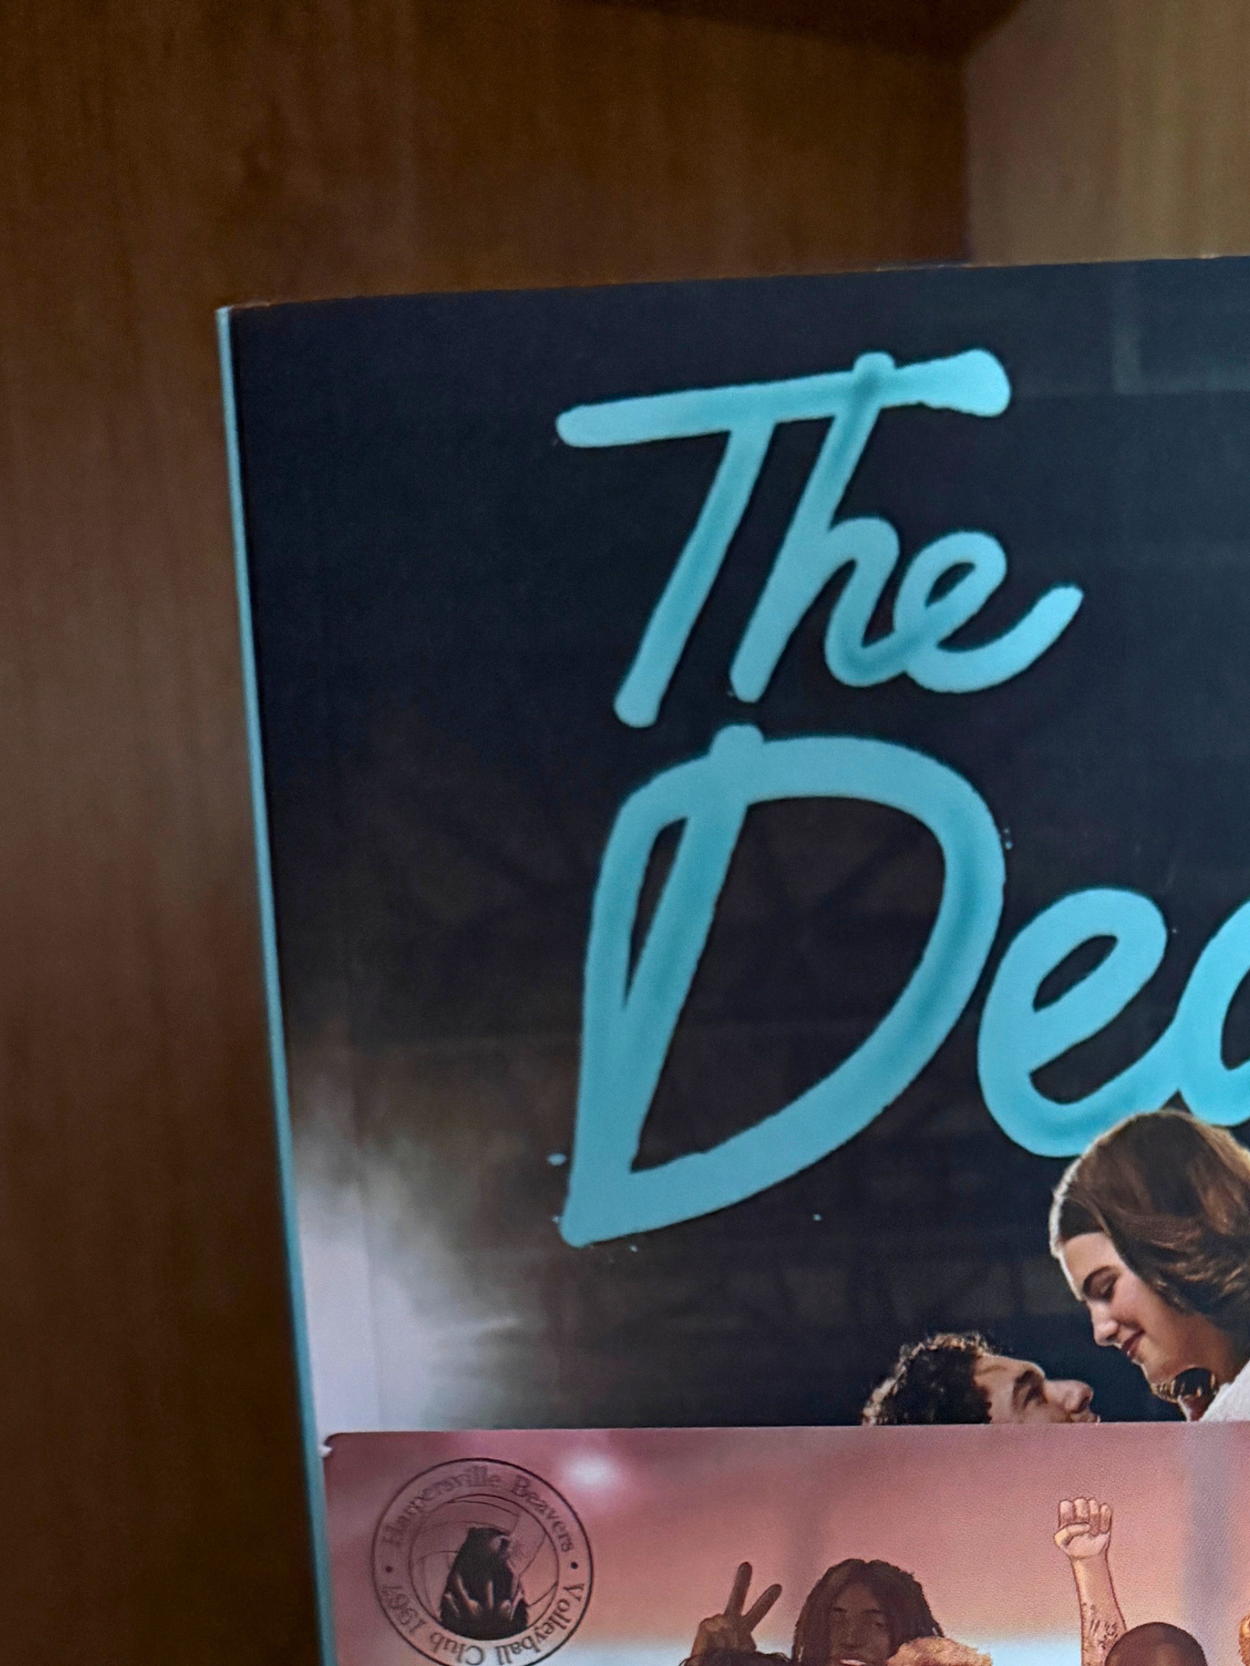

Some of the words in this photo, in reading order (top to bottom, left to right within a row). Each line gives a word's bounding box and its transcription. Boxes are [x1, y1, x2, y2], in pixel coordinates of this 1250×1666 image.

[555, 347, 1083, 730] The
[510, 1475, 575, 1553] Beavers
[430, 1632, 486, 1666] Club
[495, 1581, 586, 1666] Volleyball
